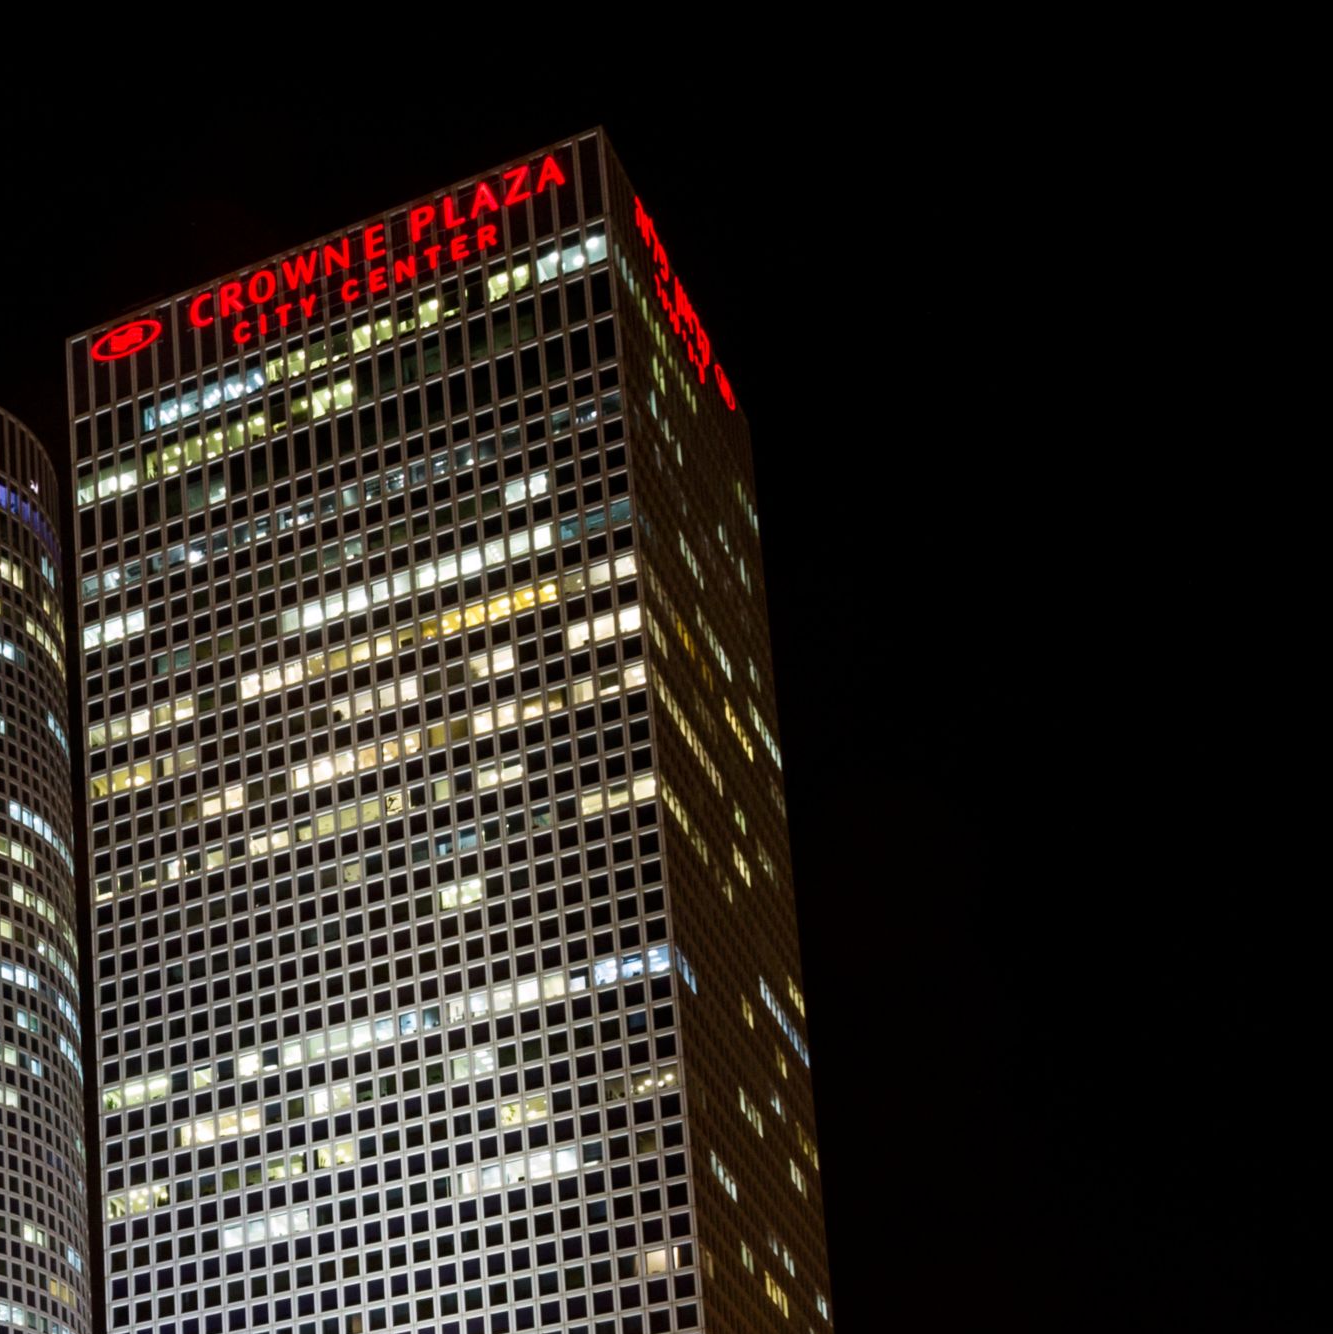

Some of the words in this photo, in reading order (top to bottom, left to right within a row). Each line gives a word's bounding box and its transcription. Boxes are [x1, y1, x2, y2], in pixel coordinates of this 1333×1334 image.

[188, 223, 388, 330] CROWNE
[407, 155, 566, 244] PLAZA
[232, 293, 317, 346] CITY
[340, 223, 498, 304] CENTER
